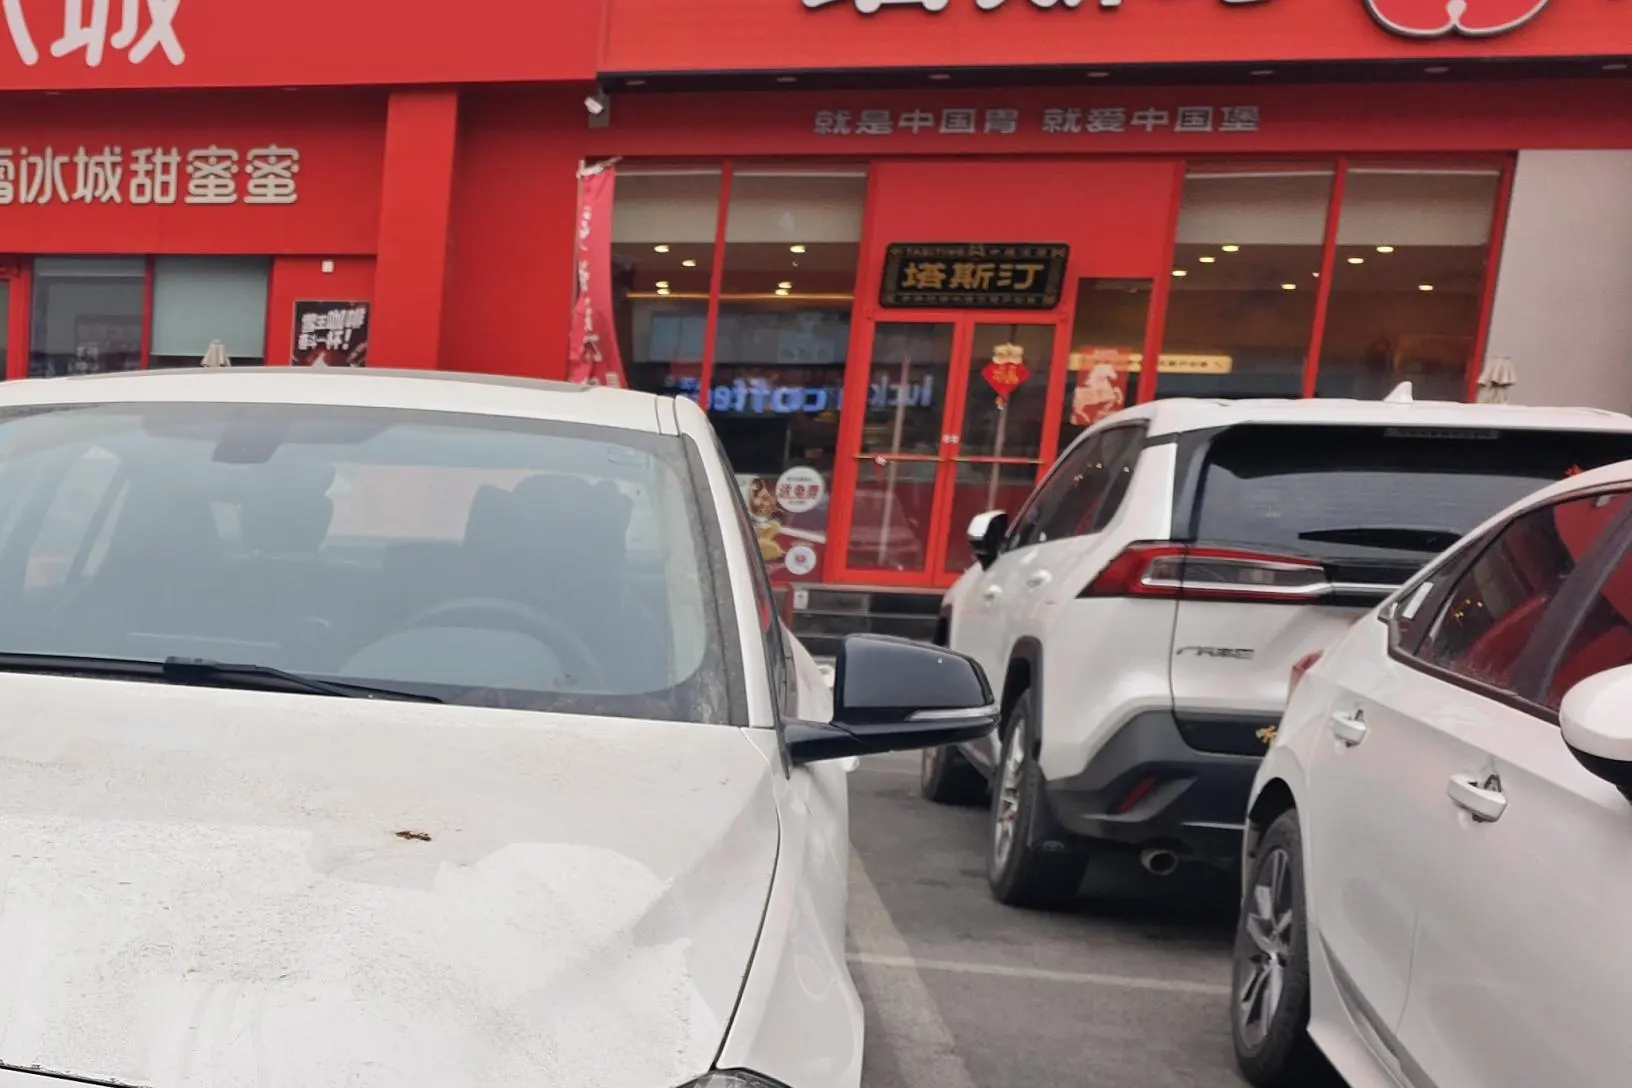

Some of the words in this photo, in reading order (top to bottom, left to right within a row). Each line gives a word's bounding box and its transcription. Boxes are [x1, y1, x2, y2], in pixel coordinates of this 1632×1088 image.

[1042, 105, 1260, 133] 就爱中国堡
[901, 262, 1045, 290] 塔斯汀
